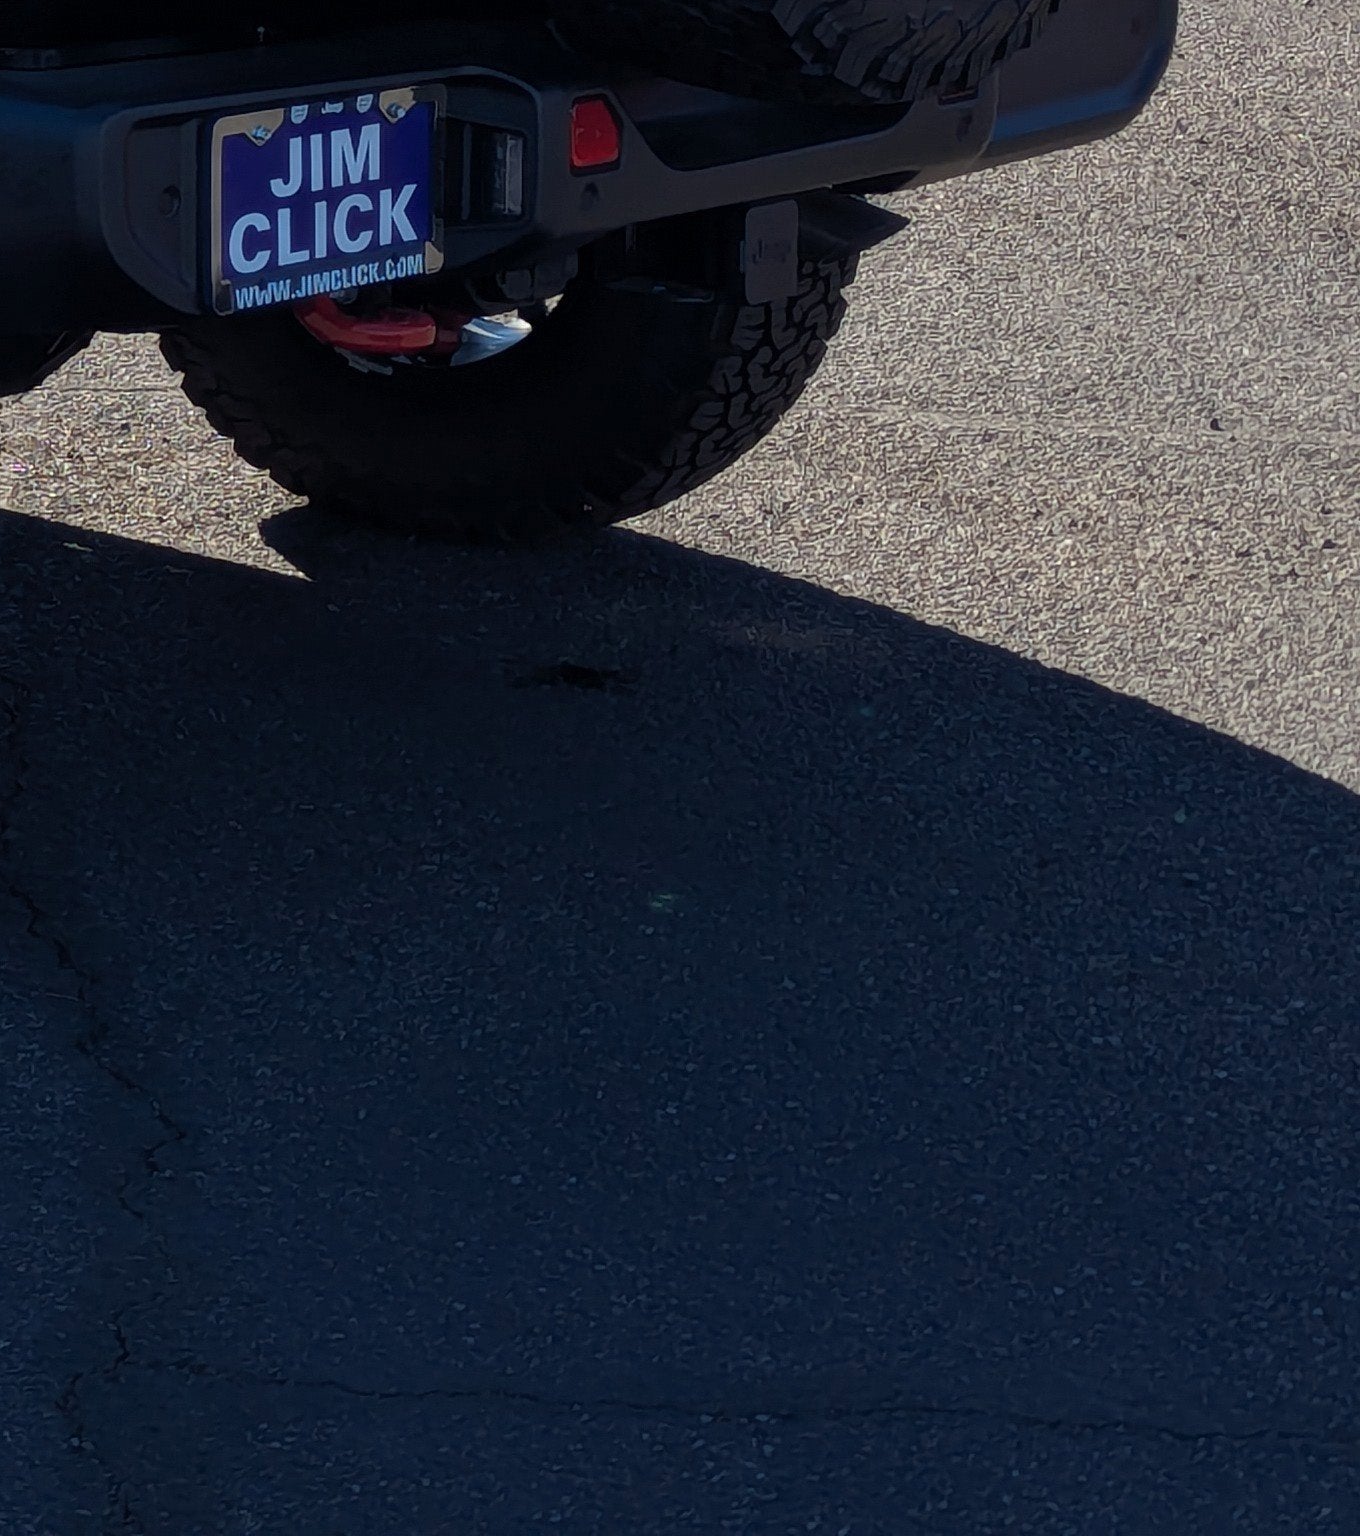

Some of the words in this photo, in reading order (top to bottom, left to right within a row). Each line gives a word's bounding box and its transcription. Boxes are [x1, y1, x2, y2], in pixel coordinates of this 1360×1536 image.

[269, 123, 381, 198] JIM
[229, 184, 418, 274] CLICK
[235, 253, 424, 310] WWW.JIMCLICK.COM
